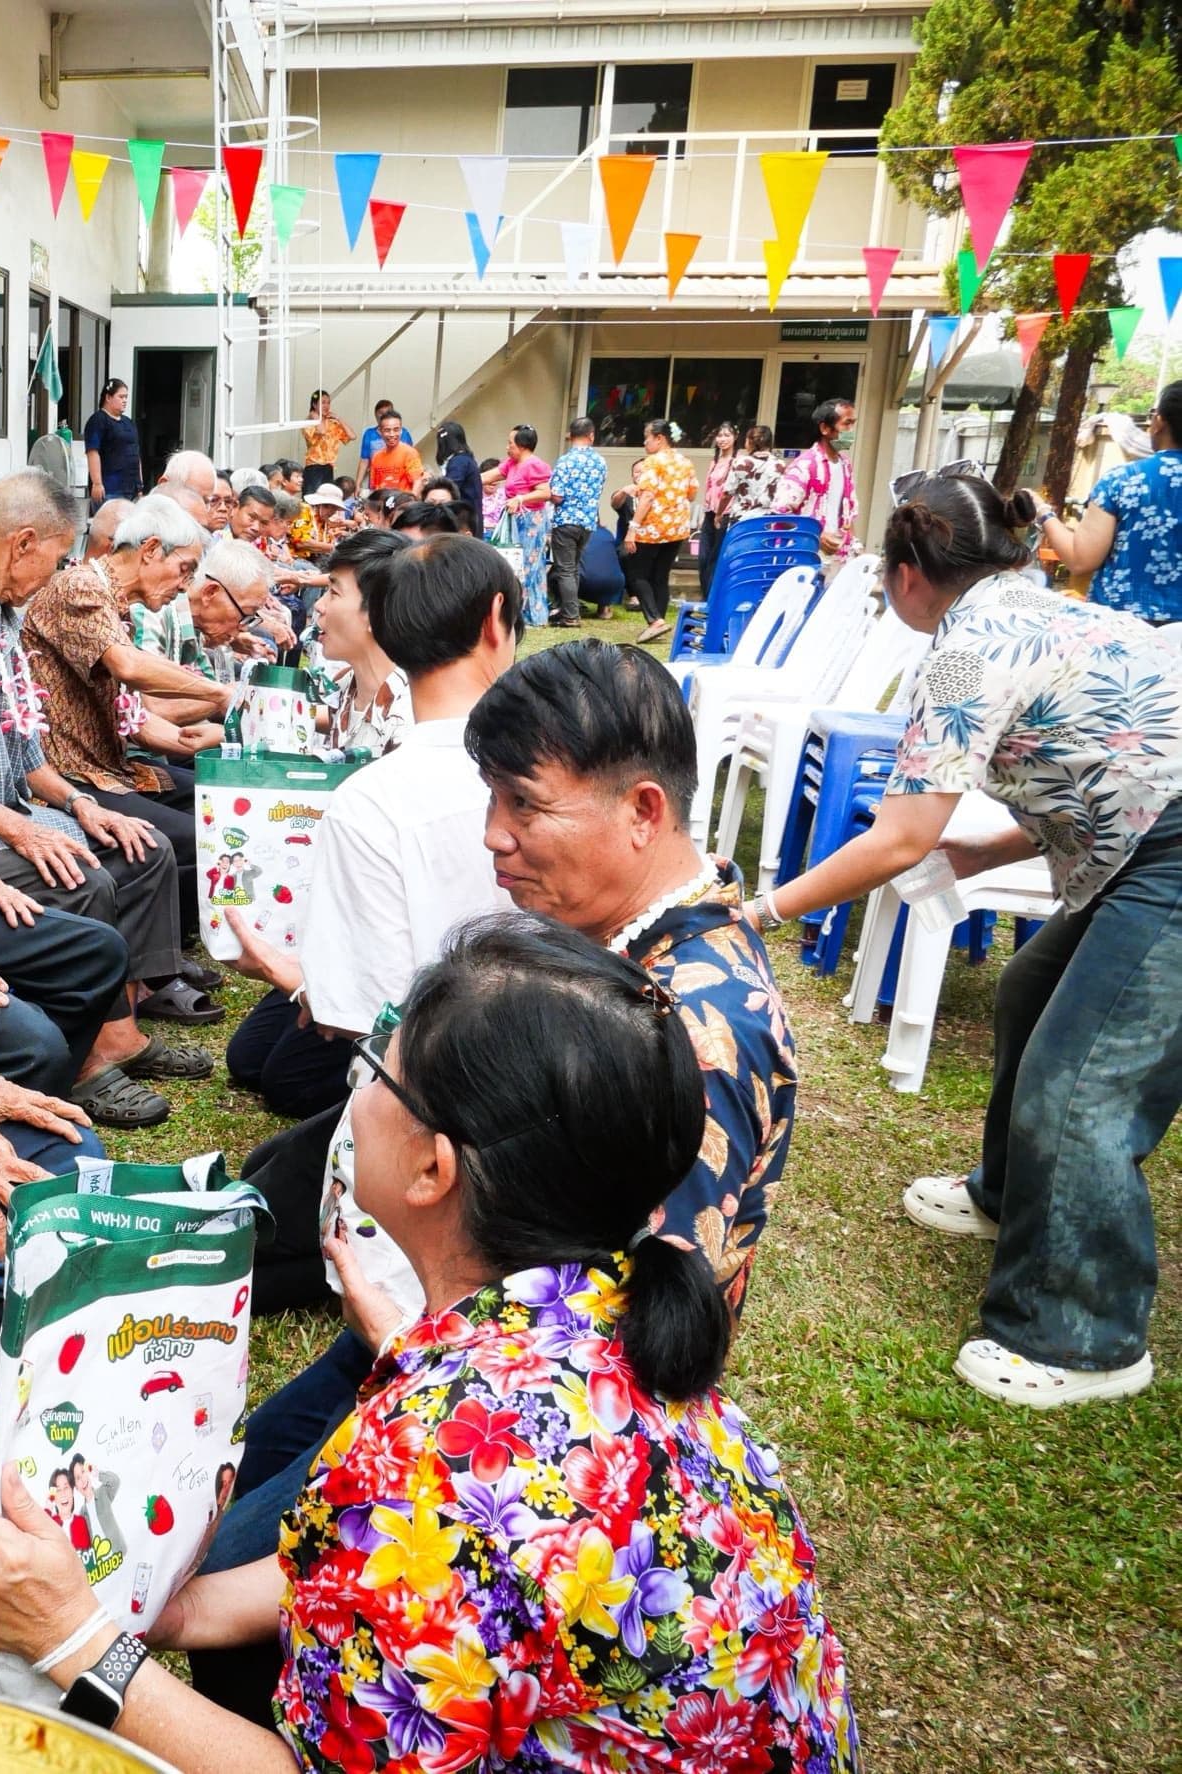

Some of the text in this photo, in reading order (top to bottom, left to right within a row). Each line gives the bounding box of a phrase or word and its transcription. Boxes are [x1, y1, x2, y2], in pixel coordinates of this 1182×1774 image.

[53, 1206, 81, 1220] DOI
[90, 1209, 161, 1233] DOI KHAM
[108, 1314, 237, 1362] เพื่อนร่วมทาง
[143, 1338, 194, 1364] ทั่วไทย
[50, 1423, 74, 1440] ดีมาก
